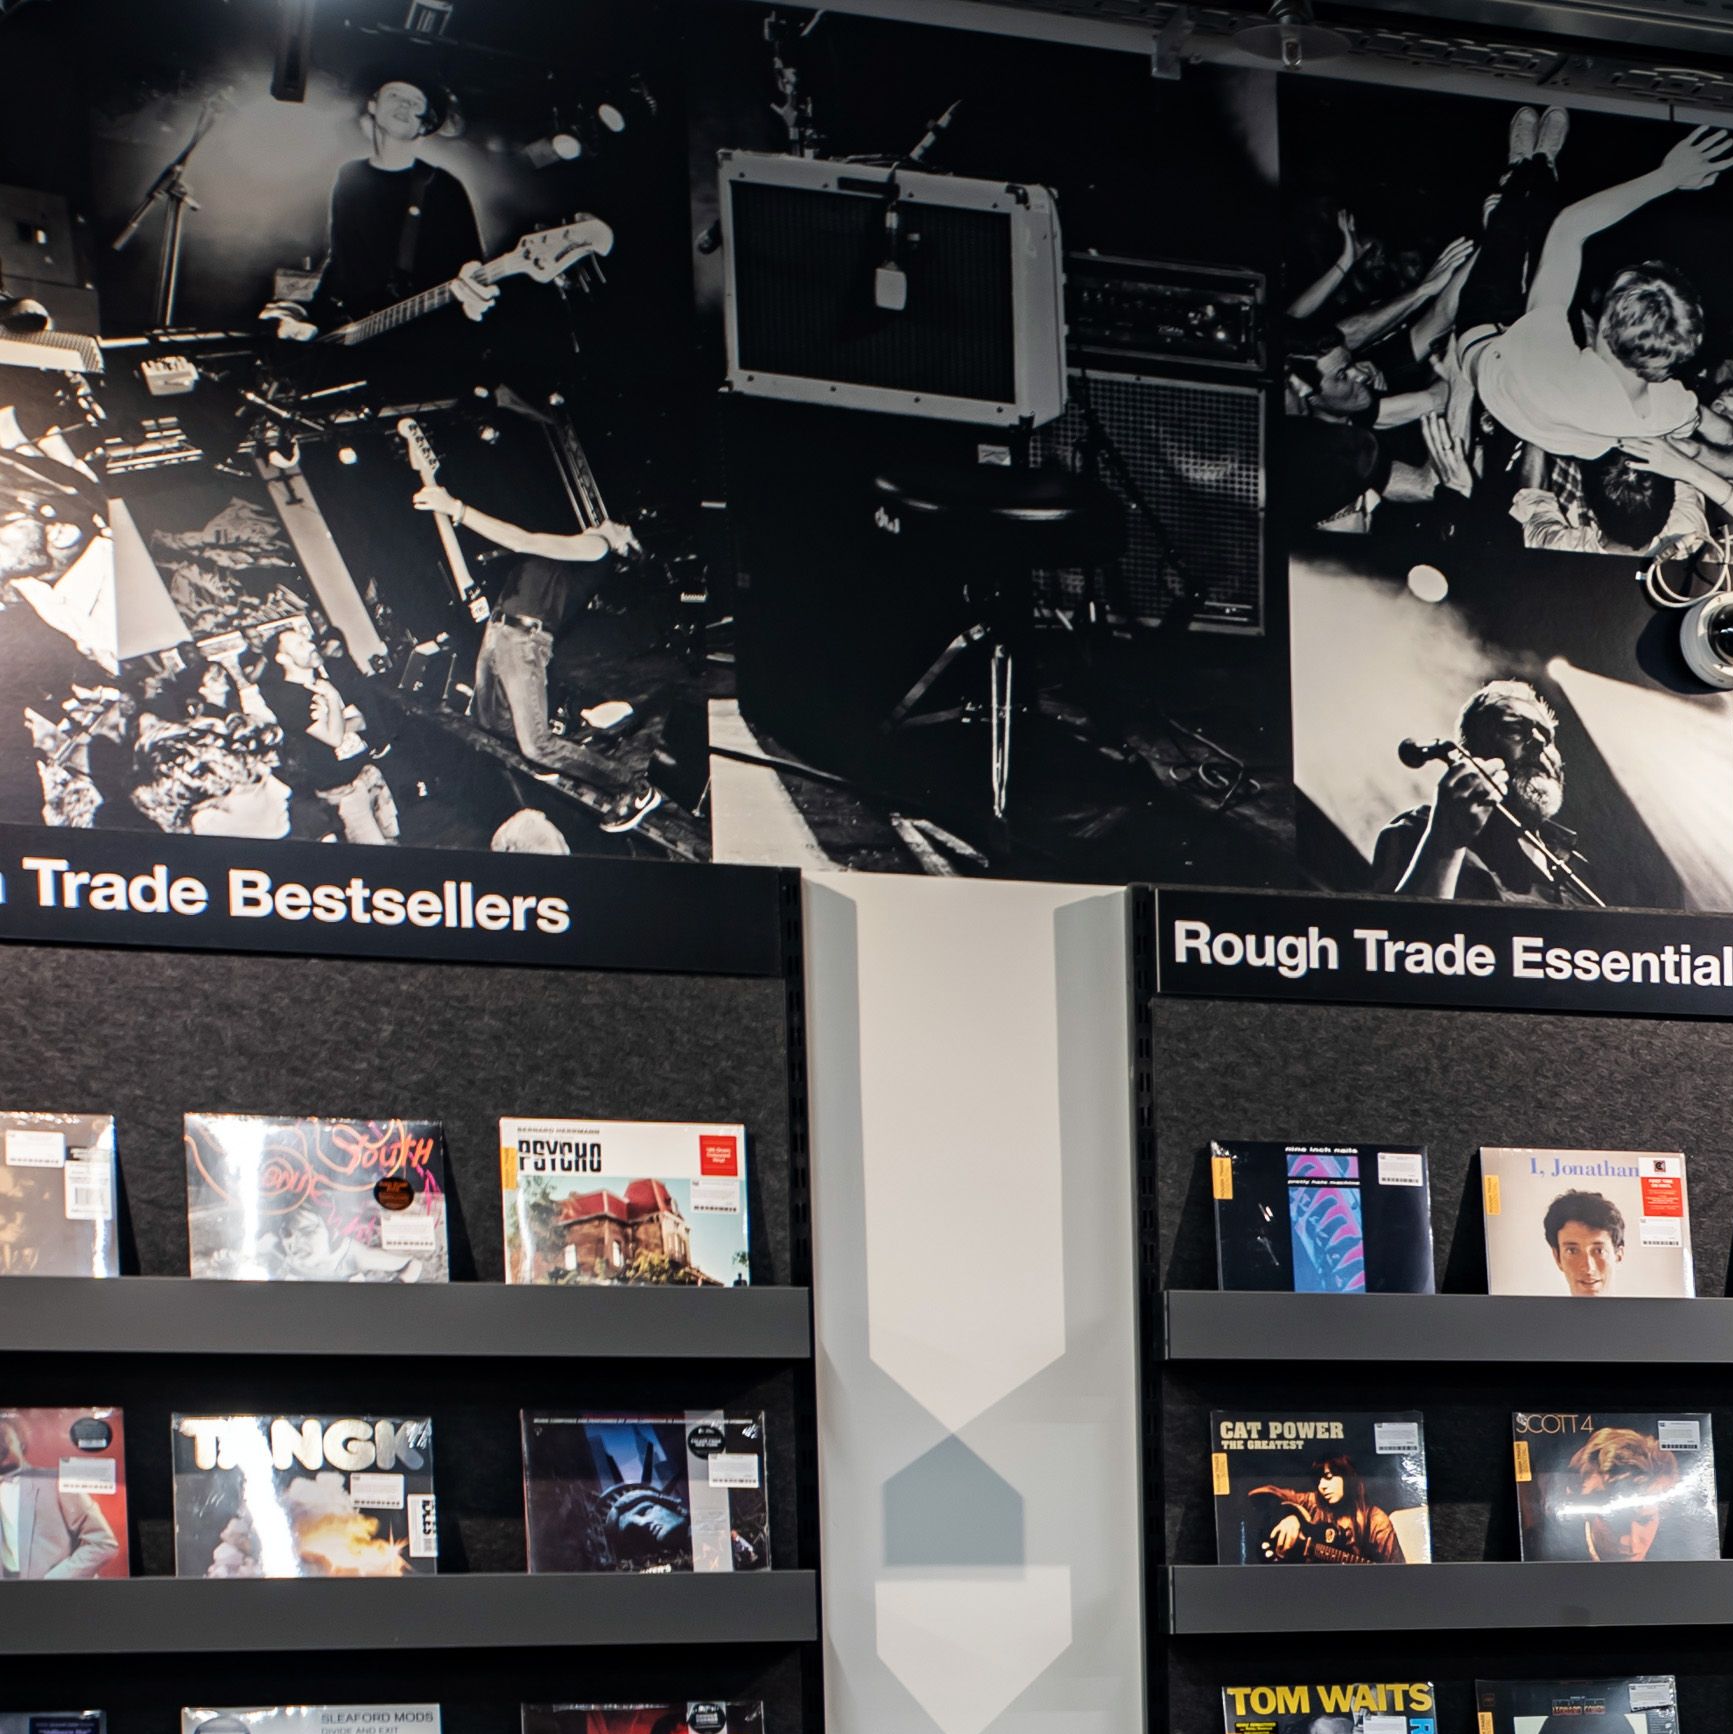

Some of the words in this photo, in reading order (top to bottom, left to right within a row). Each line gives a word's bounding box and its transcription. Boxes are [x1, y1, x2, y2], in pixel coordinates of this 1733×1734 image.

[22, 857, 208, 917] Trade
[228, 870, 571, 934] Bestsellers
[1174, 920, 1338, 979] Rough
[1354, 929, 1494, 978] Trade
[518, 1140, 601, 1172] PSYCHO
[1530, 1157, 1544, 1177] I,
[1550, 1157, 1640, 1178] Jonathan
[1220, 1422, 1262, 1440] CAT
[1270, 1421, 1344, 1439] POWER
[1516, 1414, 1575, 1434] SCOTT
[1581, 1416, 1594, 1434] 4
[1245, 1440, 1304, 1449] GREATEST
[1229, 1686, 1309, 1716] TOM
[1313, 1683, 1432, 1713] WAITS
[320, 1711, 388, 1727] SLEAFORD
[393, 1710, 434, 1725] MODS
